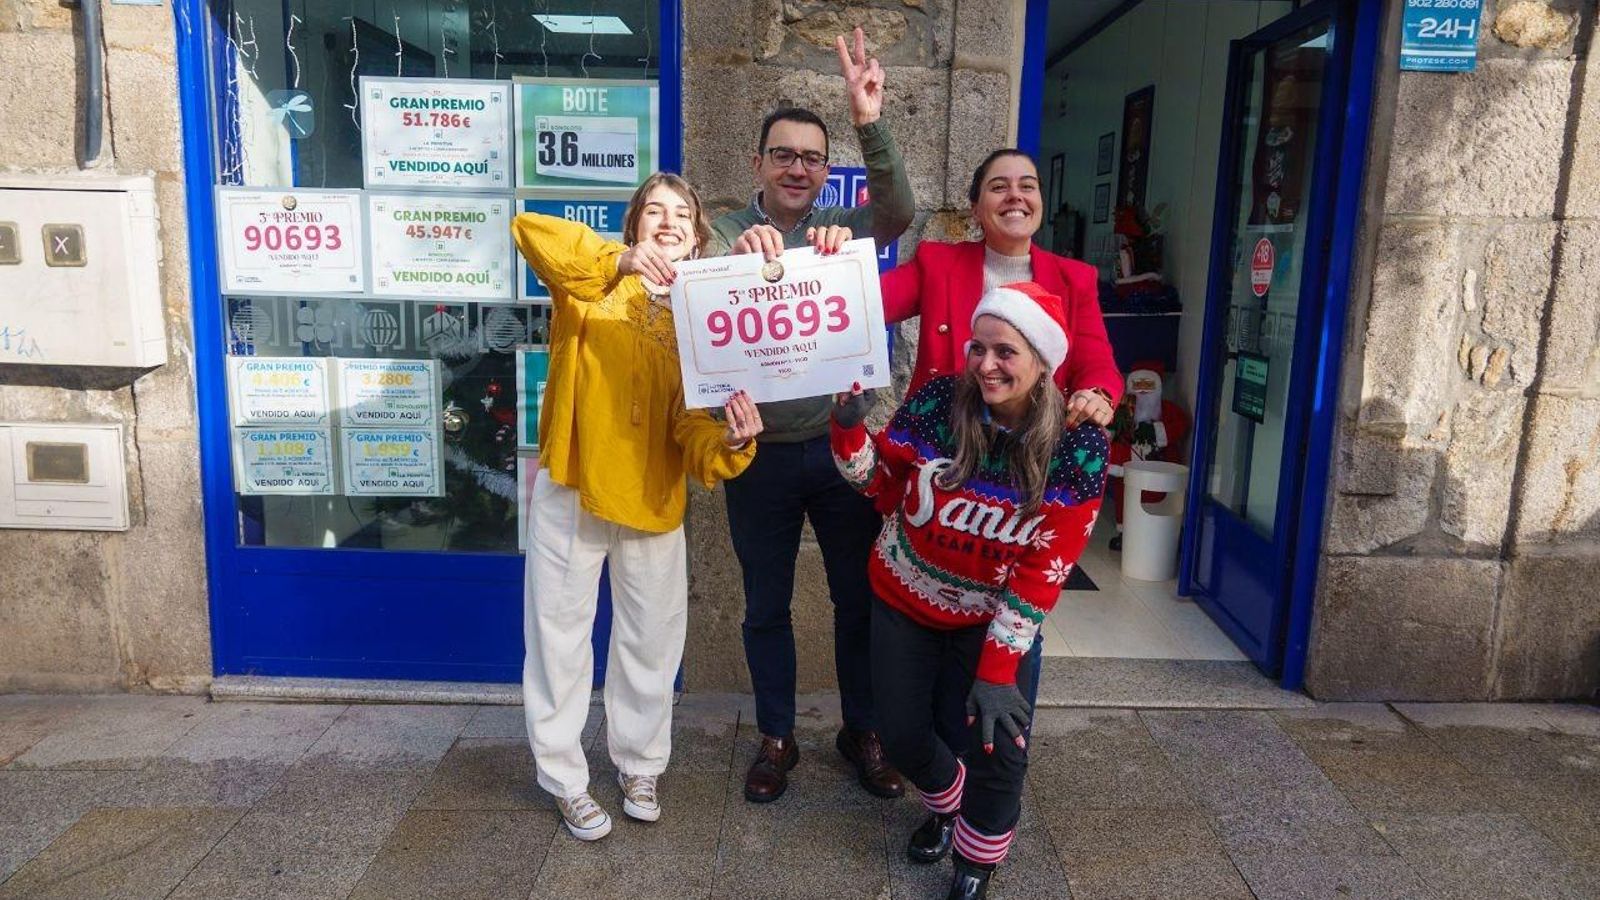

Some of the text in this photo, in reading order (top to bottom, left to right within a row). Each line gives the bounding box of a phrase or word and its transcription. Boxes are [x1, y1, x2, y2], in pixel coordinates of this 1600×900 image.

[1418, 17, 1476, 38] 24H
[390, 97, 485, 110] GRAN PREMIO
[563, 88, 608, 112] BOTE
[538, 131, 635, 168] 3.6 MILLONES
[389, 160, 488, 175] VENDIDO AQUÍ
[273, 212, 323, 223] PREMIO
[393, 210, 487, 223] GRAN PREMIO
[244, 225, 342, 251] 90693
[392, 270, 489, 285] VENDIDO AQUÍ
[748, 280, 822, 303] PREMIO
[706, 295, 850, 347] 90693
[744, 346, 790, 358] VENDIDO
[247, 363, 313, 371] GRAN PREMIO
[349, 363, 377, 371] PREMIO
[250, 410, 289, 418] VENDIDO
[357, 411, 395, 419] VENDIDO
[250, 433, 316, 441] GRAN PREMIO
[356, 434, 422, 442] GRAN PREMIO
